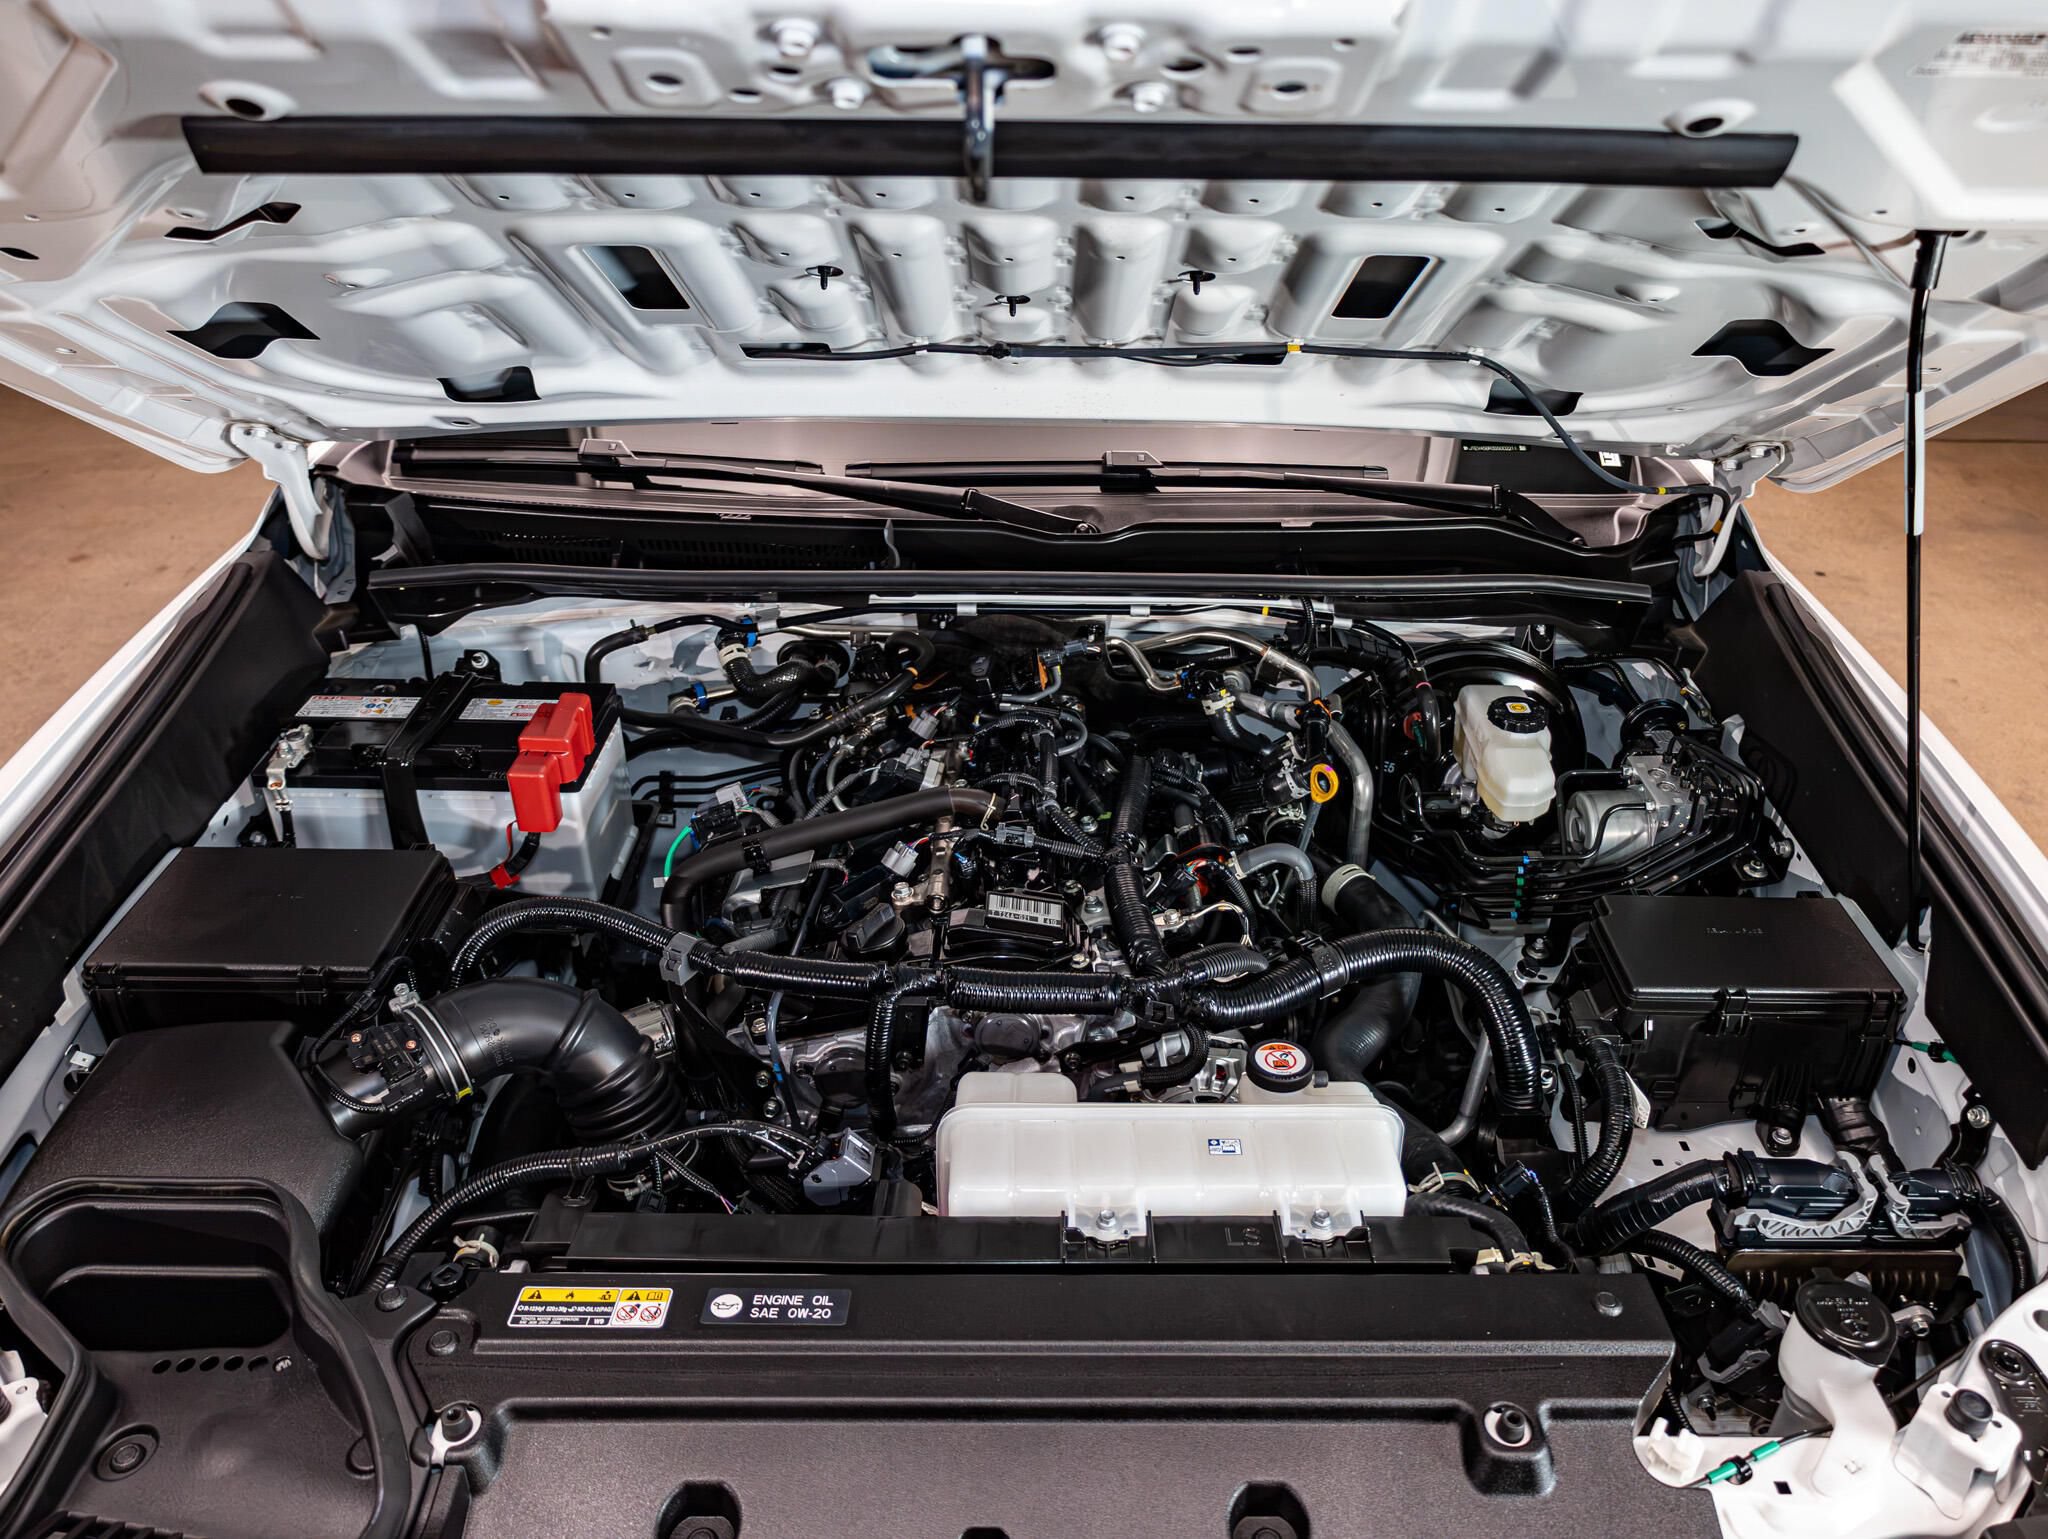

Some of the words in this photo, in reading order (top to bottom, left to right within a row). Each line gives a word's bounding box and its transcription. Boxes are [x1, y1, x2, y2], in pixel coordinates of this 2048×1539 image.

[753, 1294, 804, 1306] ENGINE
[812, 1295, 834, 1306] OIL
[749, 1307, 780, 1319] SAE
[787, 1307, 832, 1319] 0W-20
